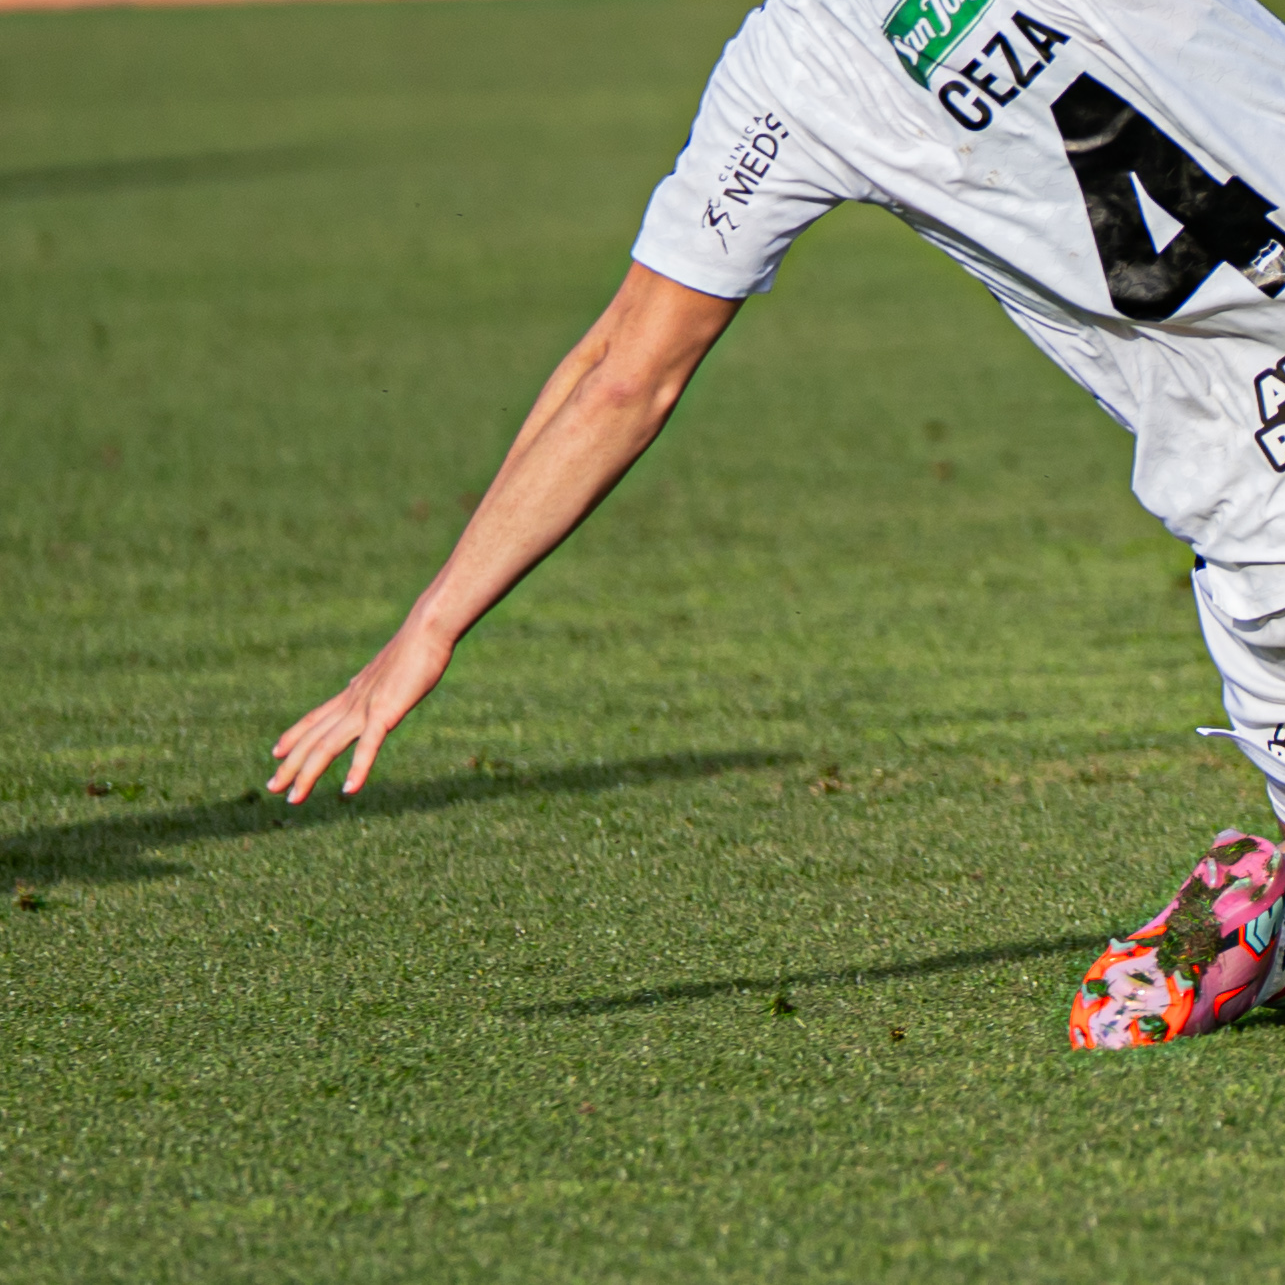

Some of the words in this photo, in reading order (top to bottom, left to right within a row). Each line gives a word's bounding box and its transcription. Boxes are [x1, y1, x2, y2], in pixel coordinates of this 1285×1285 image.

[938, 10, 1072, 132] CEZA
[719, 116, 763, 182] CLINICA
[723, 112, 790, 205] MEDS
